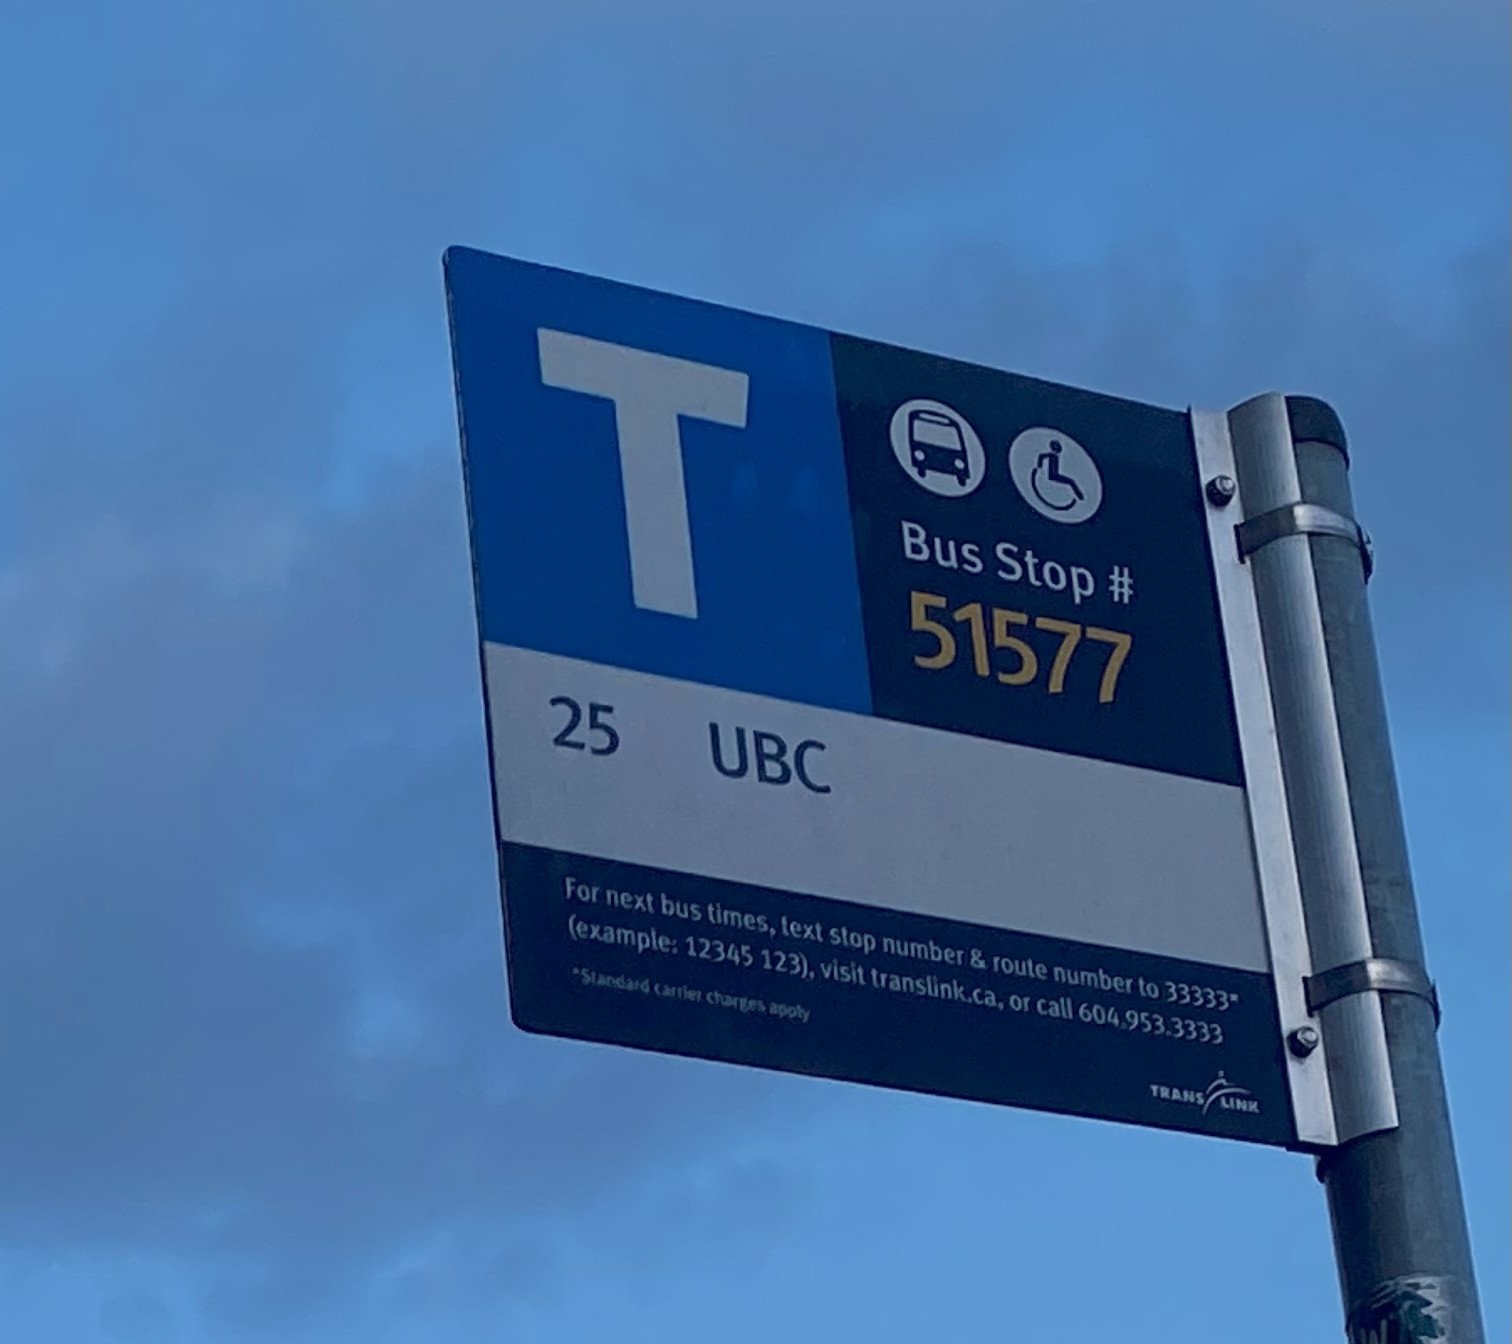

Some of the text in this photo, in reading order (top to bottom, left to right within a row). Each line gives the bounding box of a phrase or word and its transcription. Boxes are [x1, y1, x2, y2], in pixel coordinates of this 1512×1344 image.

[537, 327, 749, 619] T
[901, 520, 1134, 605] Bus Stop #
[910, 590, 1133, 703] 51577
[549, 696, 831, 794] 25 UBC
[565, 876, 600, 903] For
[606, 888, 655, 913] next
[661, 892, 702, 921] bus
[707, 902, 777, 937] times,
[781, 916, 824, 943] text
[829, 925, 876, 955] stop
[882, 936, 965, 966] number
[970, 948, 987, 968] &
[992, 953, 1048, 980] route
[1053, 965, 1133, 995] number
[1138, 978, 1159, 999] to
[568, 913, 1224, 1045] (example: 12345 123), visit translink.ca, or call 604.953.3333
[654, 983, 702, 1003] carrier
[706, 990, 766, 1015] charges
[770, 1001, 812, 1024] apply
